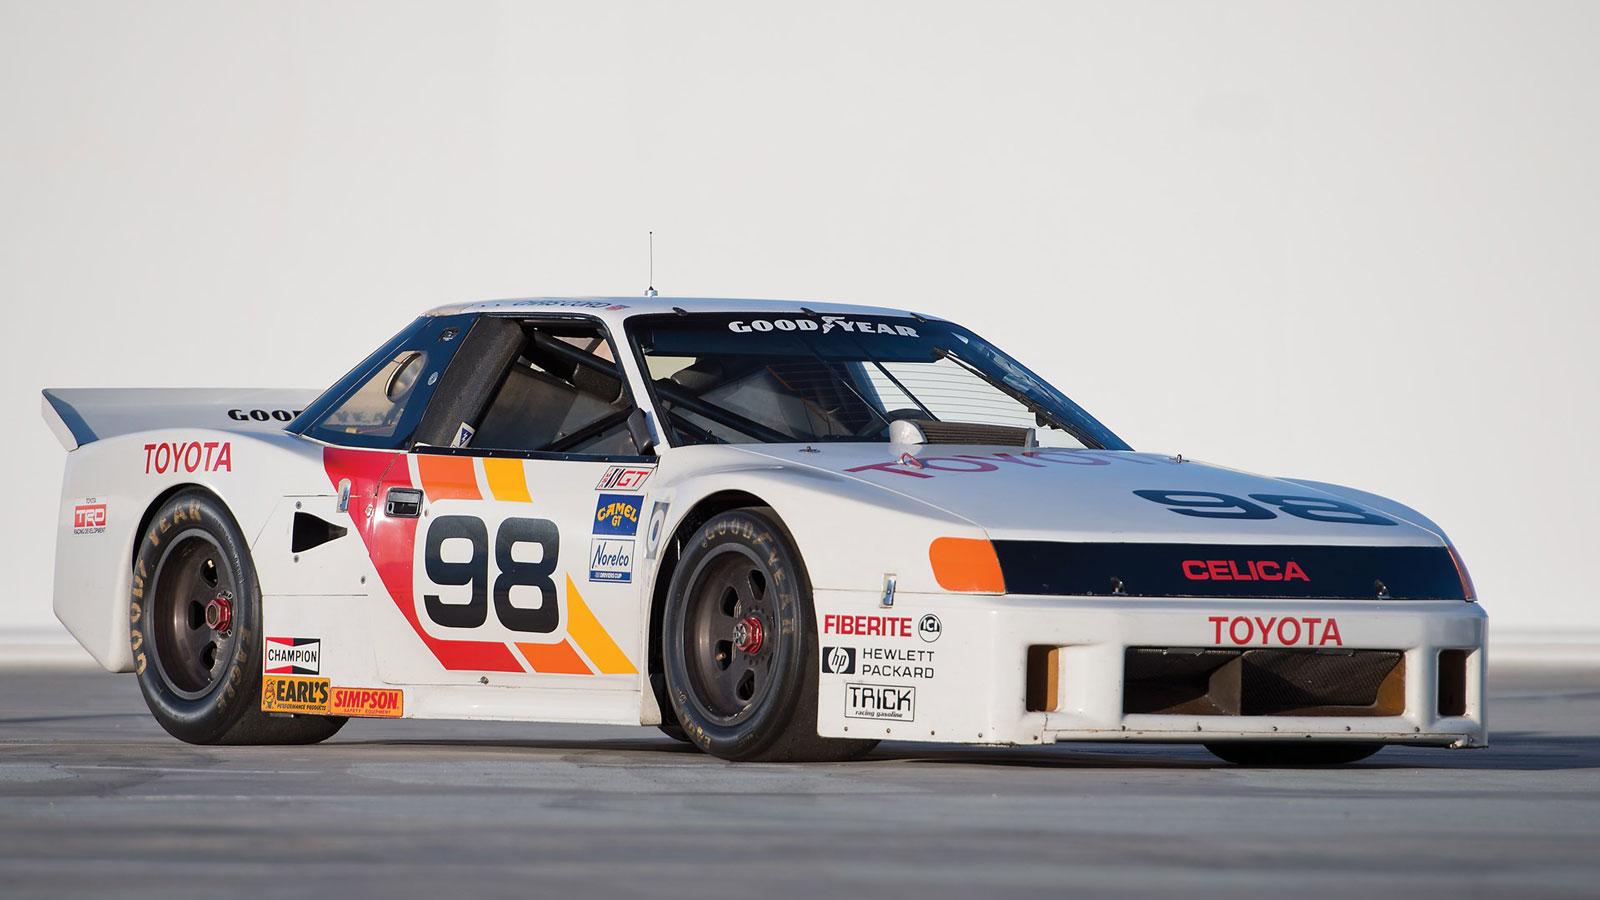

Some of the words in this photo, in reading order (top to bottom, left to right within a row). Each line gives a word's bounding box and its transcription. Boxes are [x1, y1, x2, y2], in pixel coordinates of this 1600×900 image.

[143, 441, 232, 474] TOYOTA
[616, 470, 649, 487] GT
[76, 508, 105, 527] TRD
[597, 502, 638, 523] CAMEL
[1132, 489, 1399, 526] 98
[611, 515, 623, 527] GT
[591, 541, 629, 569] Norelco
[424, 515, 560, 633] 98
[1181, 560, 1310, 582] CELICA
[823, 614, 913, 637] FIBERITE
[1208, 616, 1343, 646] TOYOTA
[268, 648, 317, 663] CHAMPION
[862, 648, 935, 661] HEWLETT
[862, 664, 935, 679] PACKARD
[276, 680, 329, 704] EARL'S
[334, 690, 399, 709] SIMPSON
[849, 686, 912, 711] TRICK
[855, 709, 874, 717] racing
[877, 710, 903, 718] gasoline
